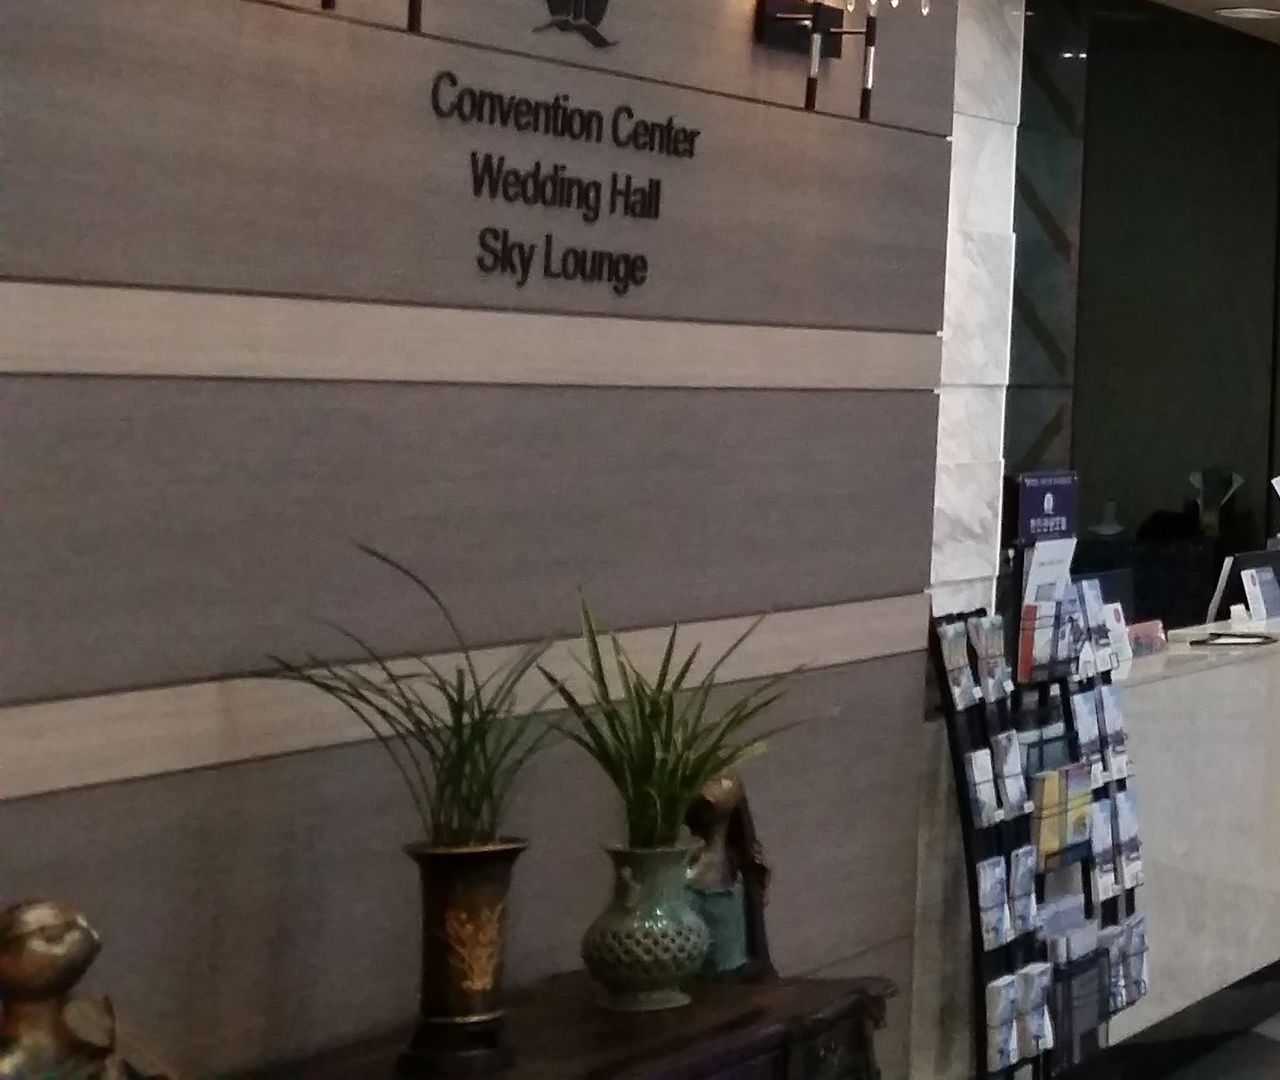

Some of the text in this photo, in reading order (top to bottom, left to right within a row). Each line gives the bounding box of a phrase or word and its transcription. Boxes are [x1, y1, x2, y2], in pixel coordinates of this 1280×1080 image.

[431, 70, 701, 159] Convention Center
[470, 151, 662, 223] Wedding Hall
[477, 227, 648, 296] Sky Lounge
